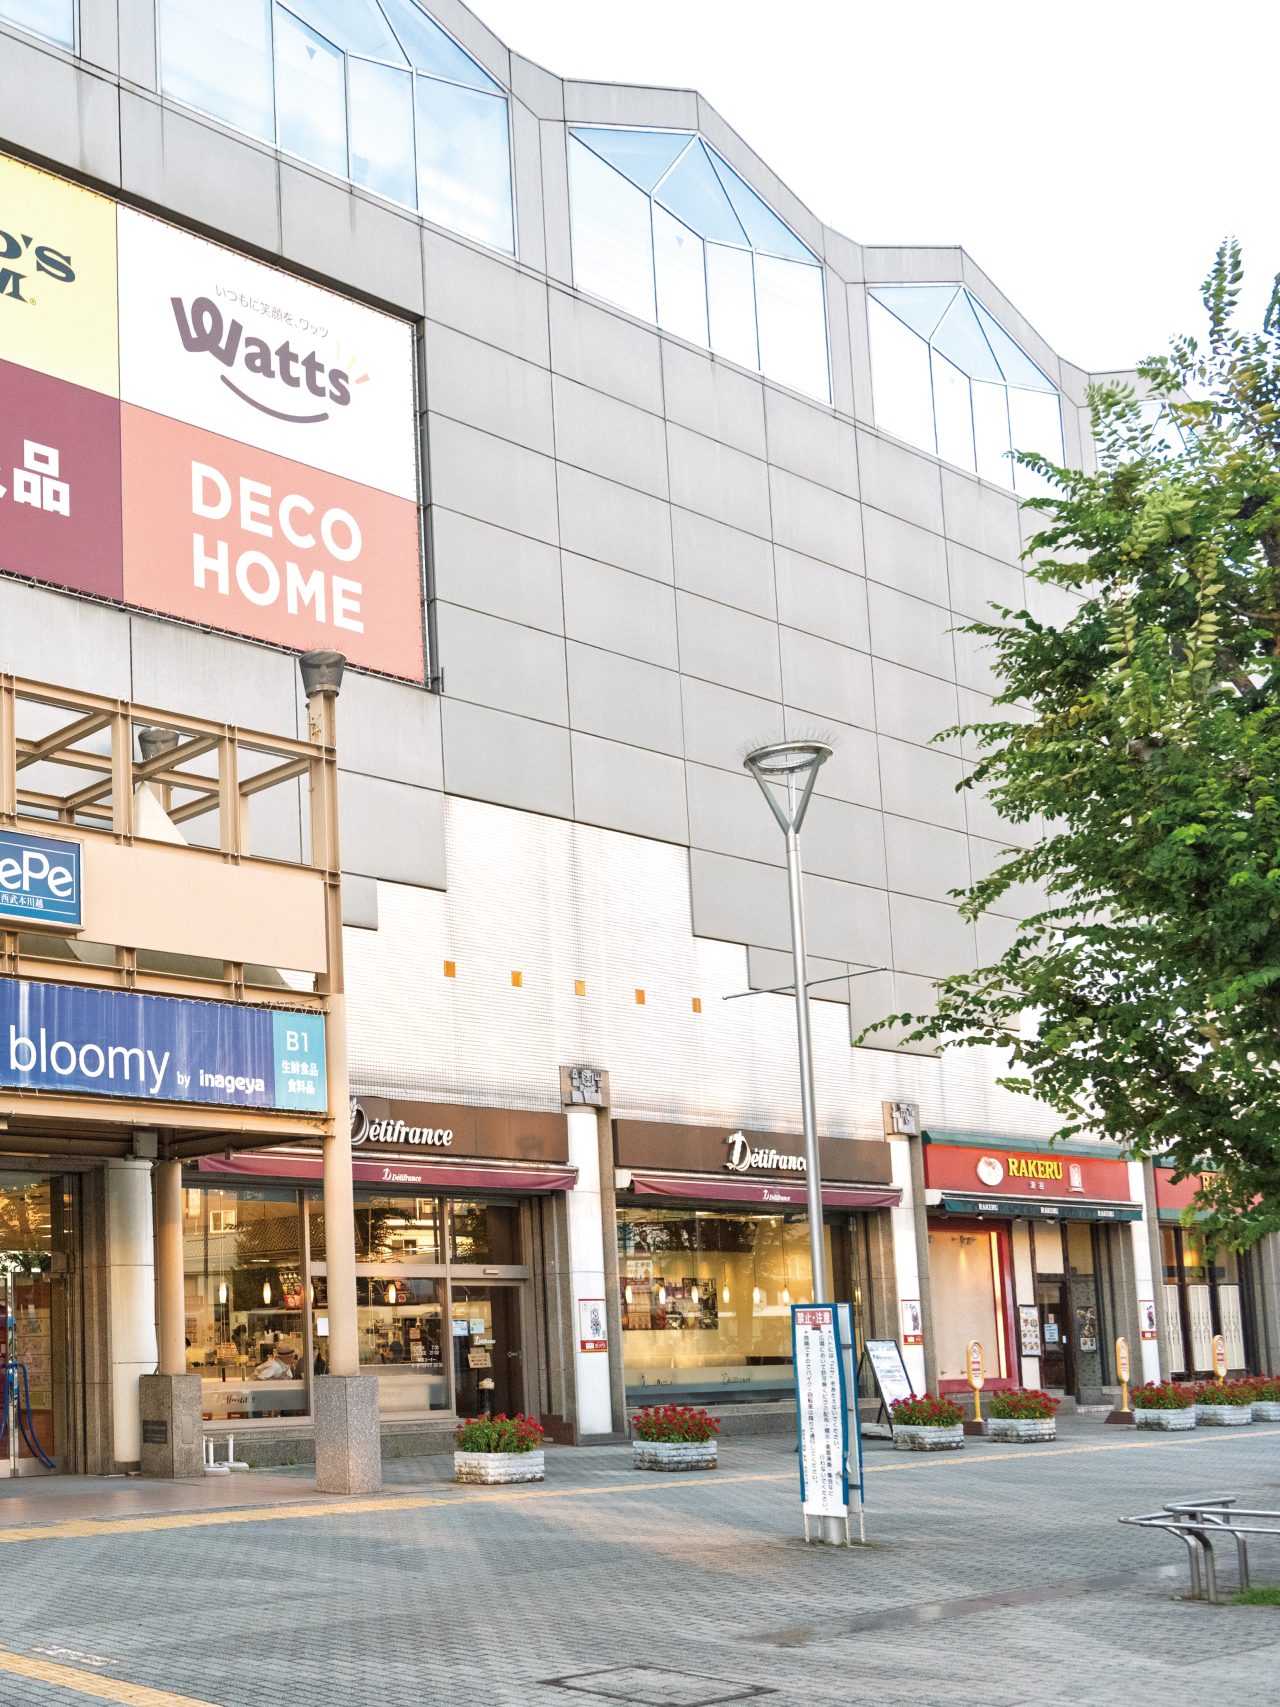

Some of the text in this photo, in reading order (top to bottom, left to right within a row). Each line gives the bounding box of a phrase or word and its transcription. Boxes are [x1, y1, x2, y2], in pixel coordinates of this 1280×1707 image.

[170, 296, 351, 406] Watts
[191, 460, 362, 562] DECO
[192, 532, 365, 634] HOME
[0, 893, 44, 909] 西武本川越
[286, 1030, 310, 1053] B1
[9, 1024, 170, 1094] bloomy
[176, 1071, 191, 1089] by
[199, 1070, 265, 1094] inageya
[281, 1060, 319, 1077] 生鮮食品
[287, 1078, 316, 1095] 食料品
[723, 1130, 807, 1172] Délifranc
[1008, 1158, 1063, 1180] RAKERU
[797, 1311, 831, 1324] 禁止・注意
